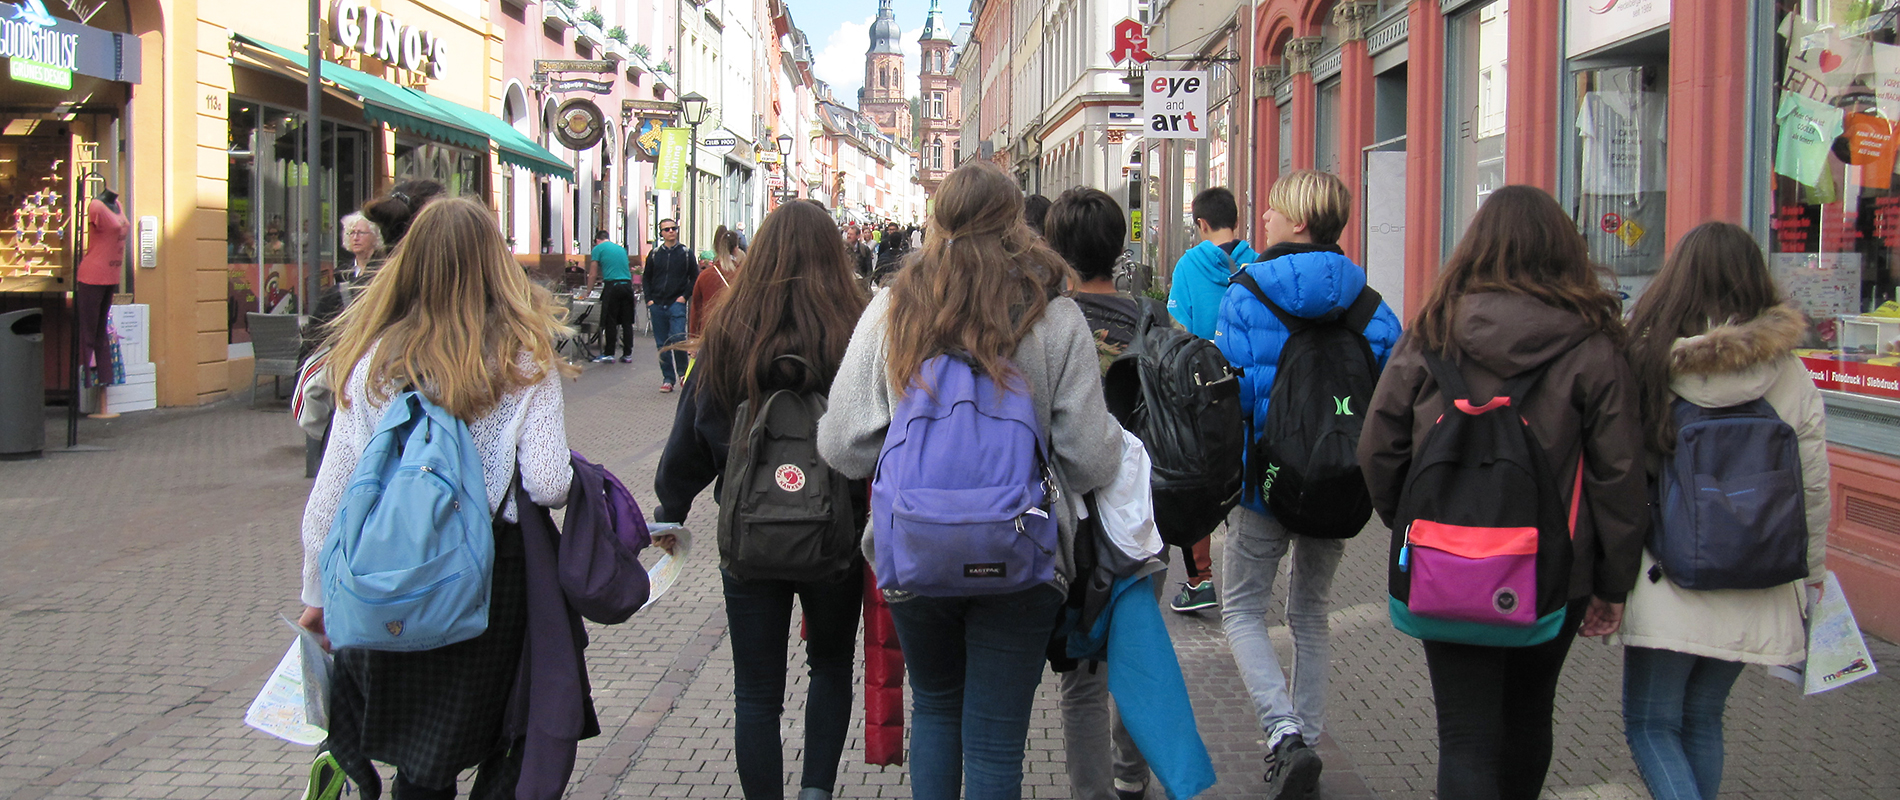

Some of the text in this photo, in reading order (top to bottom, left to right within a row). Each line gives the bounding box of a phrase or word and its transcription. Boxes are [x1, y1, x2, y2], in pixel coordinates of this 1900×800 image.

[336, 0, 447, 80] GINO'S
[12, 61, 70, 86] GRÜNES DESIGN
[1151, 77, 1200, 98] eye
[1166, 100, 1184, 110] and
[1152, 111, 1199, 132] art
[1867, 377, 1899, 390] Siebdruck
